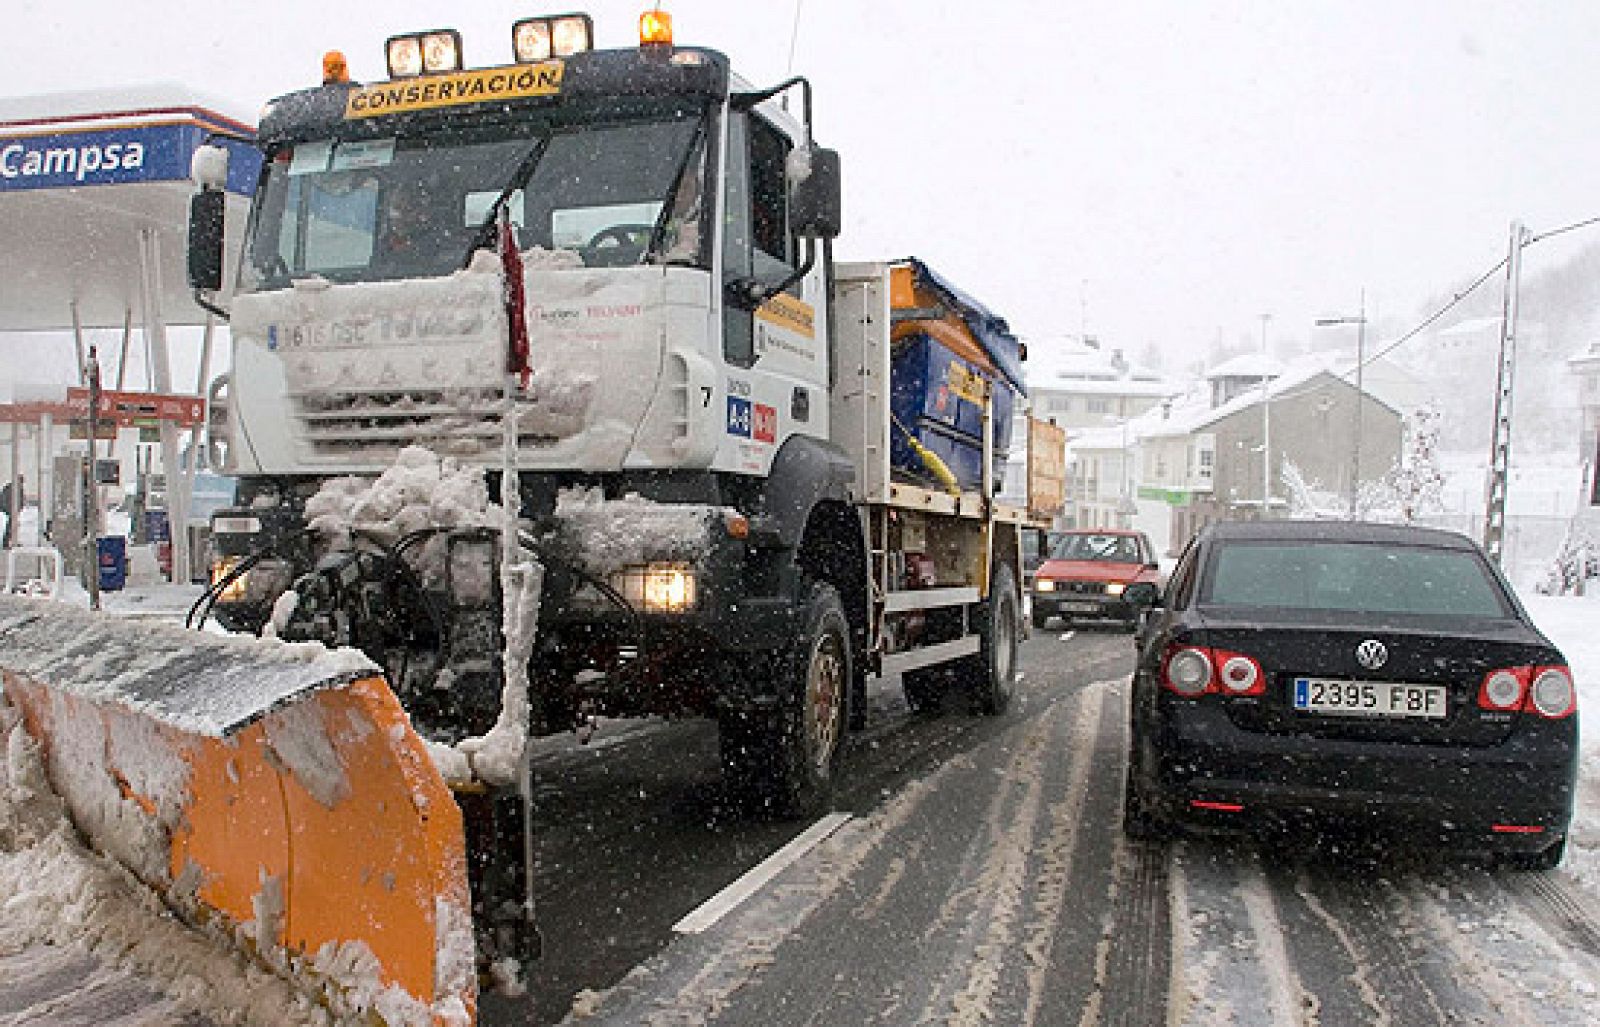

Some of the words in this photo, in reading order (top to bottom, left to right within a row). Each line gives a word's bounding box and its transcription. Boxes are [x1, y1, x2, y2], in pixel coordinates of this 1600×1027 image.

[351, 69, 557, 112] CONSERVACIÓN
[1, 142, 144, 181] Campsa
[1311, 683, 1378, 708] 2395
